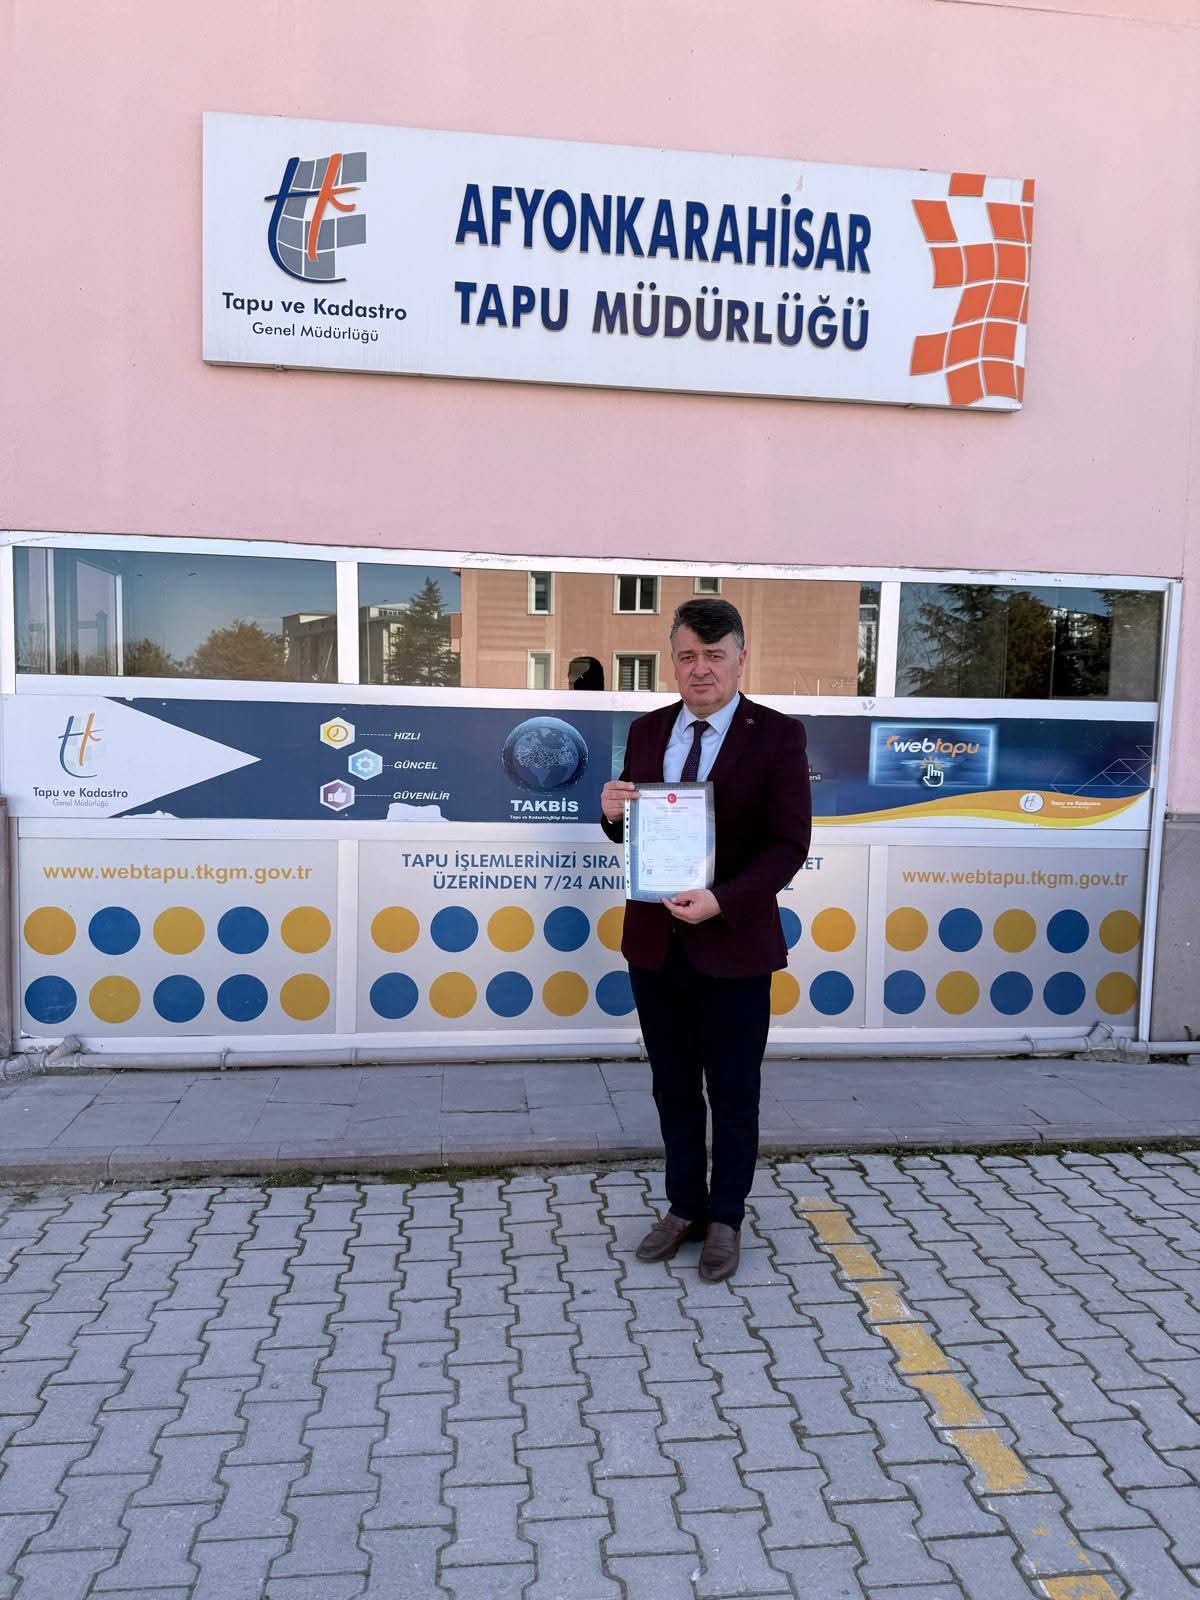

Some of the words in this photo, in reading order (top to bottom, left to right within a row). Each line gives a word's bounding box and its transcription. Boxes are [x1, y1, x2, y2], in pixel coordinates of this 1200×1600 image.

[454, 183, 872, 274] AFYONKARAHİSAR
[222, 292, 273, 315] Tapu
[280, 300, 306, 314] ve
[313, 297, 407, 321] Kadastro
[454, 281, 569, 331] TAPU
[591, 280, 870, 352] MÜDÜRLÜĞÜ
[252, 321, 295, 337] Genel
[300, 324, 379, 344] Müdürlüğü
[393, 732, 421, 741] HIZLI
[893, 738, 980, 757] webtapu
[394, 760, 438, 770] GÜNCEL
[33, 787, 60, 799] Tapu
[63, 790, 76, 798] ve
[79, 787, 129, 798] Kadastro
[52, 799, 73, 807] Genel
[393, 790, 450, 801] GÜVENİLİR
[510, 797, 579, 813] TAKBİS
[402, 853, 448, 868] TAPU
[455, 850, 576, 872] İŞLEMLERİNİZİ
[582, 854, 621, 869] SIRA
[43, 864, 313, 884] www.webtapu.tkgm.gov.tr
[433, 871, 537, 890] ÜZERİNDEN
[543, 875, 583, 891] 7/24
[902, 868, 1128, 889] www.webtapu.tkgm.gov.tr
